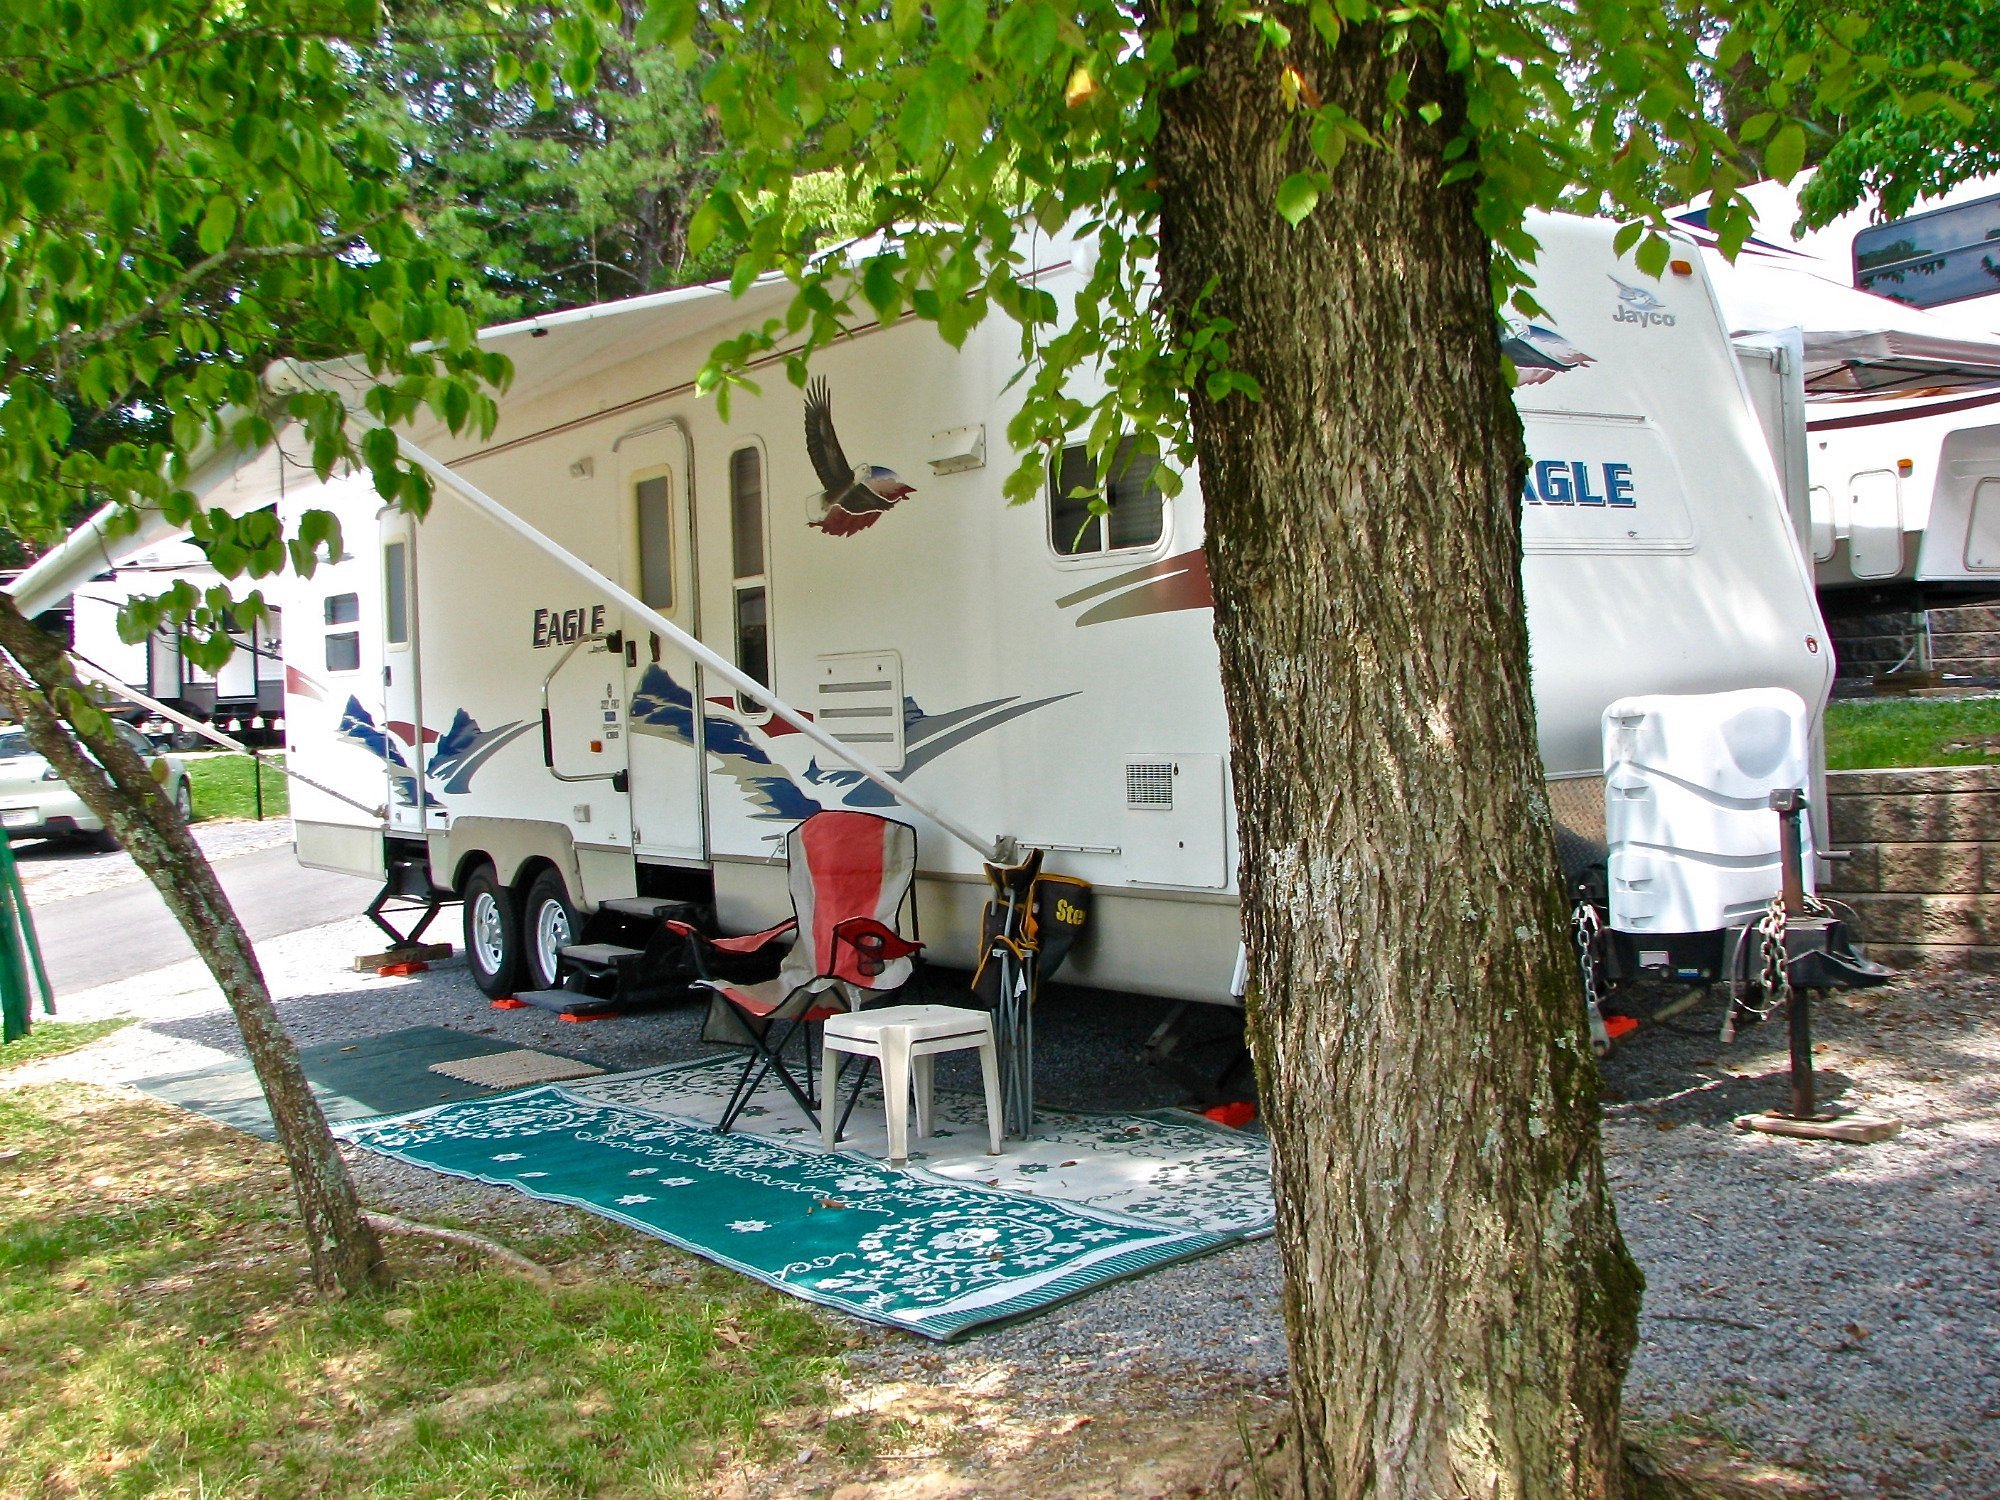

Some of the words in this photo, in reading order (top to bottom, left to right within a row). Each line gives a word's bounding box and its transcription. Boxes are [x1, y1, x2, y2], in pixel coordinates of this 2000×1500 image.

[1612, 304, 1676, 329] Jayco
[1521, 460, 1637, 509] GLE
[533, 604, 606, 649] EAGLE
[1056, 898, 1086, 925] Ste
